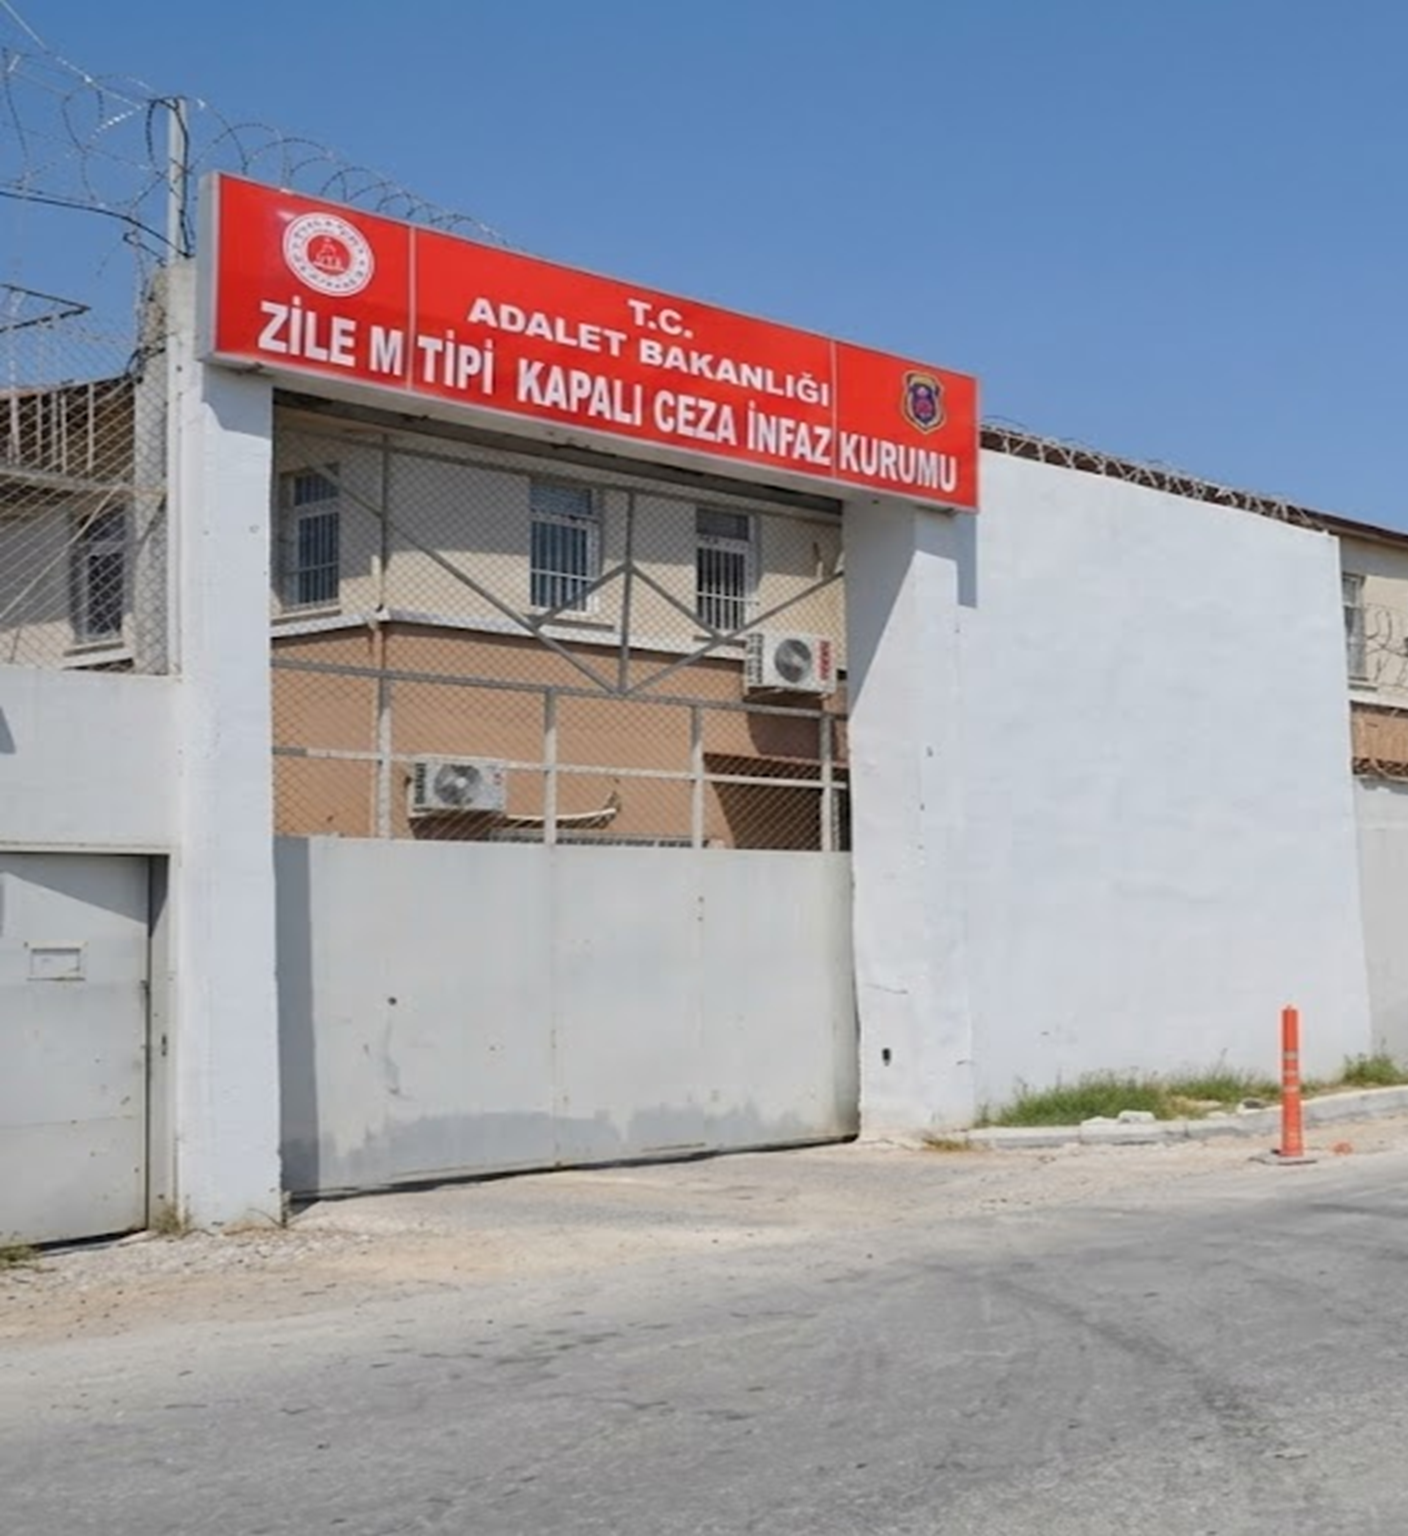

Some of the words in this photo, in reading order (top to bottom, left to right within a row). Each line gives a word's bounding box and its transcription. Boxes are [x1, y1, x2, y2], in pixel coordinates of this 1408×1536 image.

[468, 298, 627, 356] ADALET
[639, 338, 830, 407] BAKANLIĞI
[628, 299, 693, 338] T.C.
[258, 296, 356, 367] ZİLE
[369, 325, 404, 376] M
[417, 330, 494, 395] TİPİ
[517, 358, 643, 427] KAPALI
[654, 390, 738, 446] CEZA
[747, 401, 832, 466] İNFAZ
[840, 431, 958, 493] KURUMU
